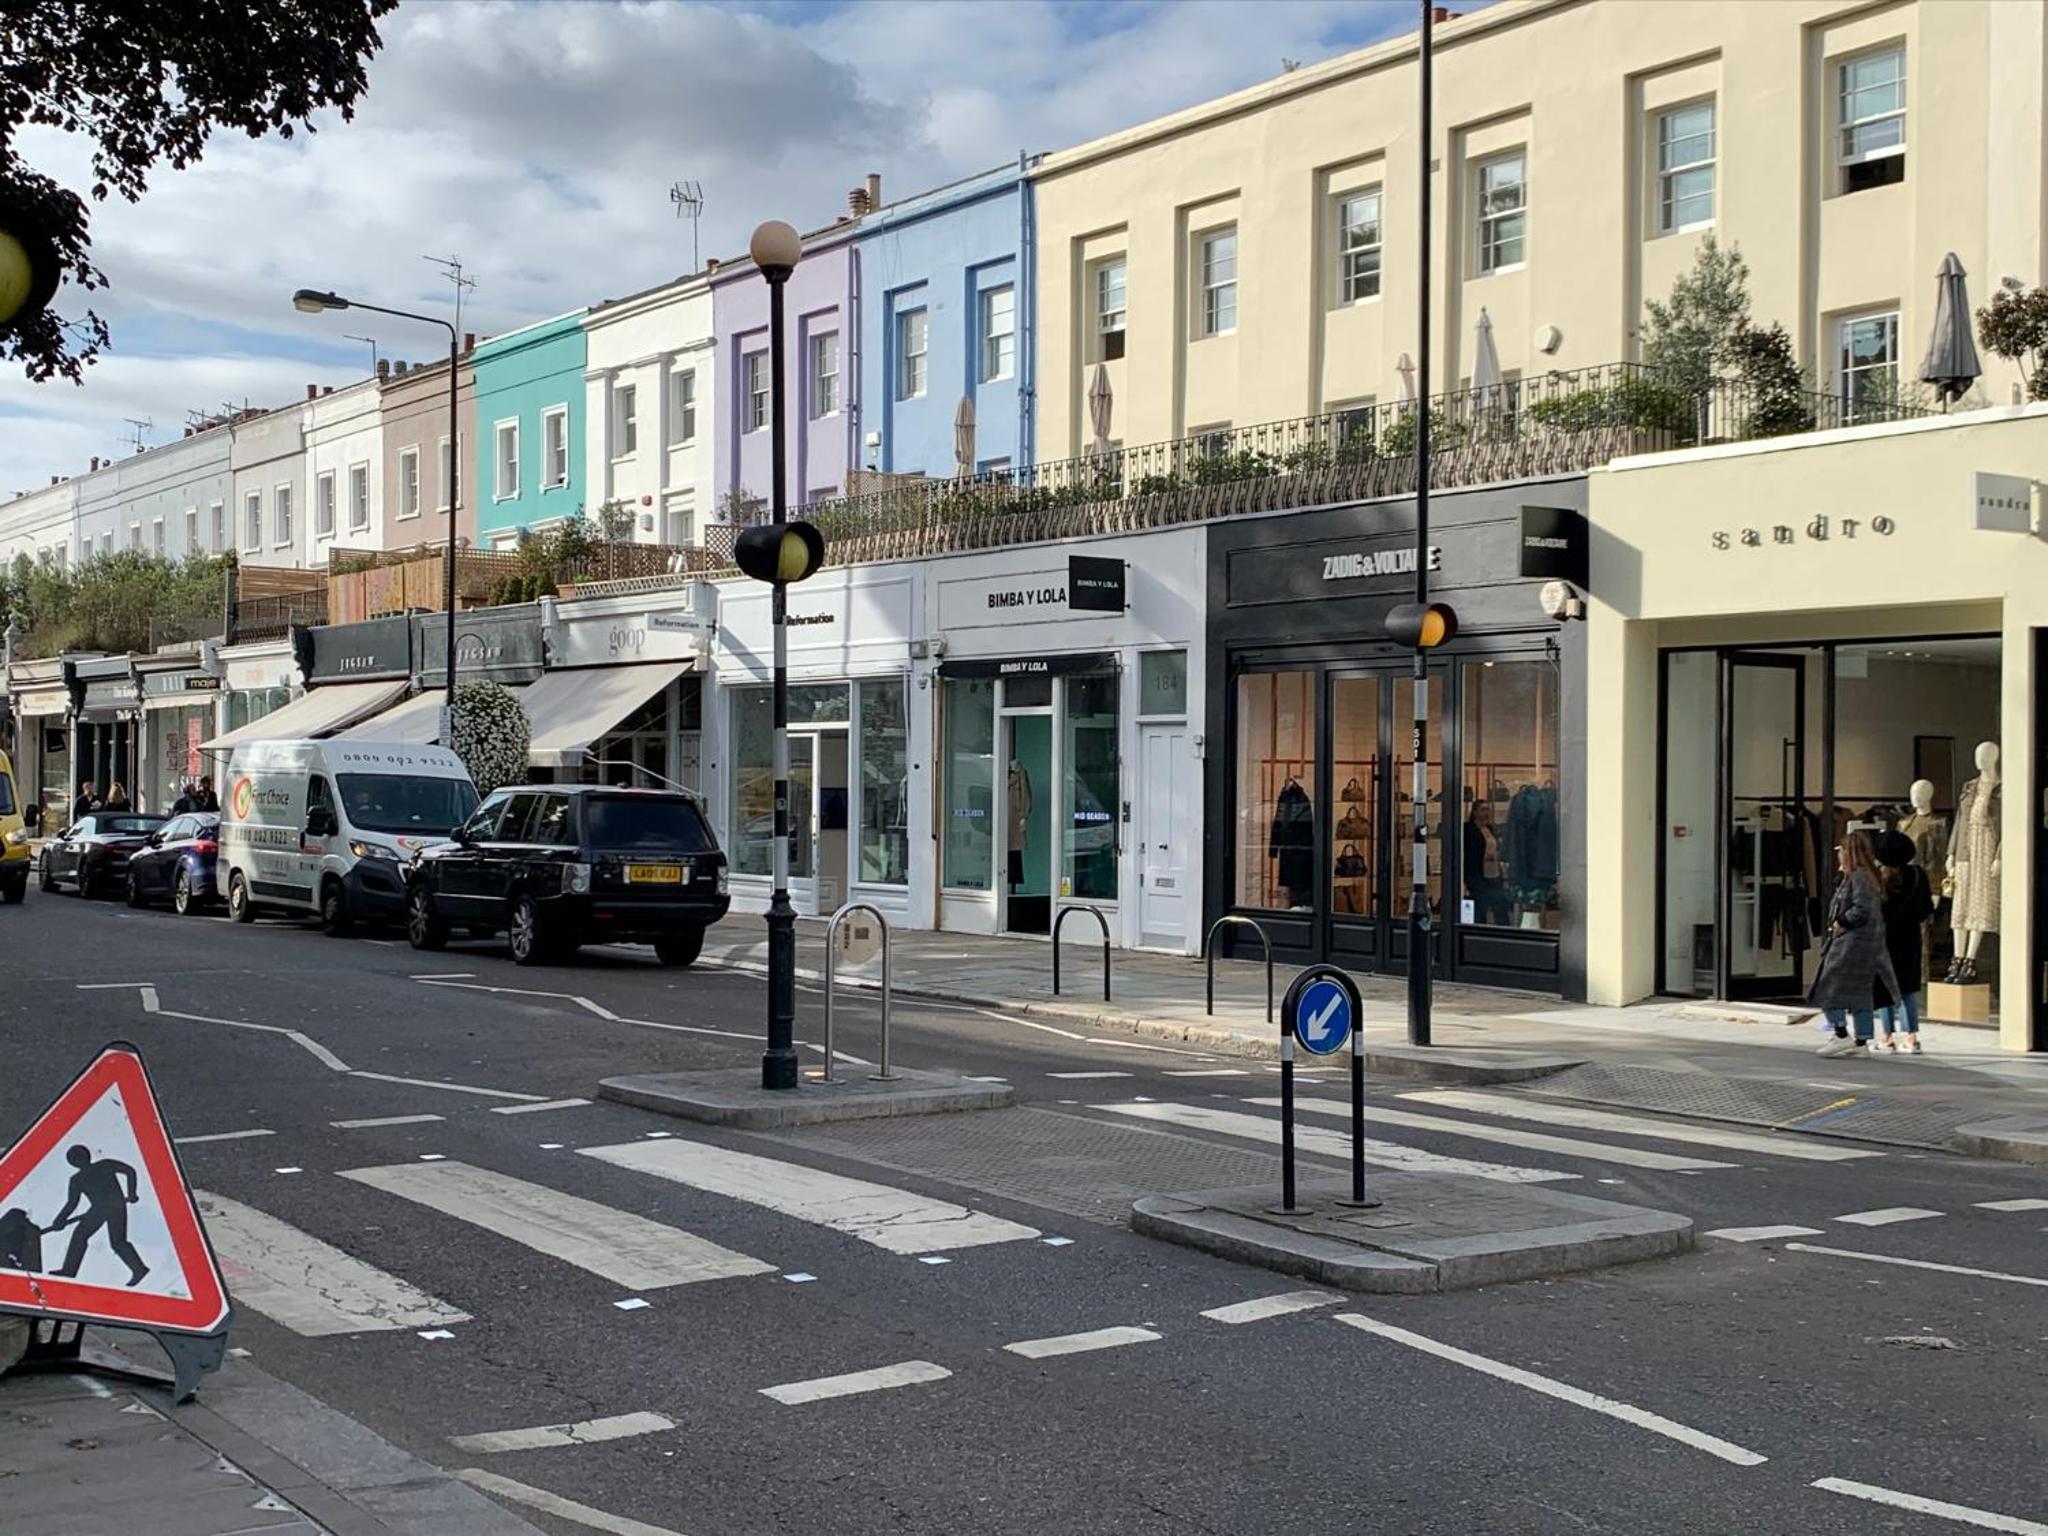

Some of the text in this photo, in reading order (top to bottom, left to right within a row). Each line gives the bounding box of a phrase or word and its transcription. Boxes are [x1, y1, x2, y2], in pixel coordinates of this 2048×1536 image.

[1980, 497, 2029, 511] sandro
[1712, 513, 1893, 549] sandro
[1077, 579, 1097, 587] BIMBA
[1103, 580, 1119, 588] LOLA
[988, 587, 1067, 608] BIMBA Y LOLA
[608, 625, 645, 657] goop
[458, 646, 502, 662] JIGSAW
[339, 656, 376, 672] JIGSAW
[1000, 662, 1048, 673] BIMBA Y LOLA
[190, 679, 217, 689] maje
[1155, 674, 1178, 691] 184
[267, 788, 289, 806] Choice
